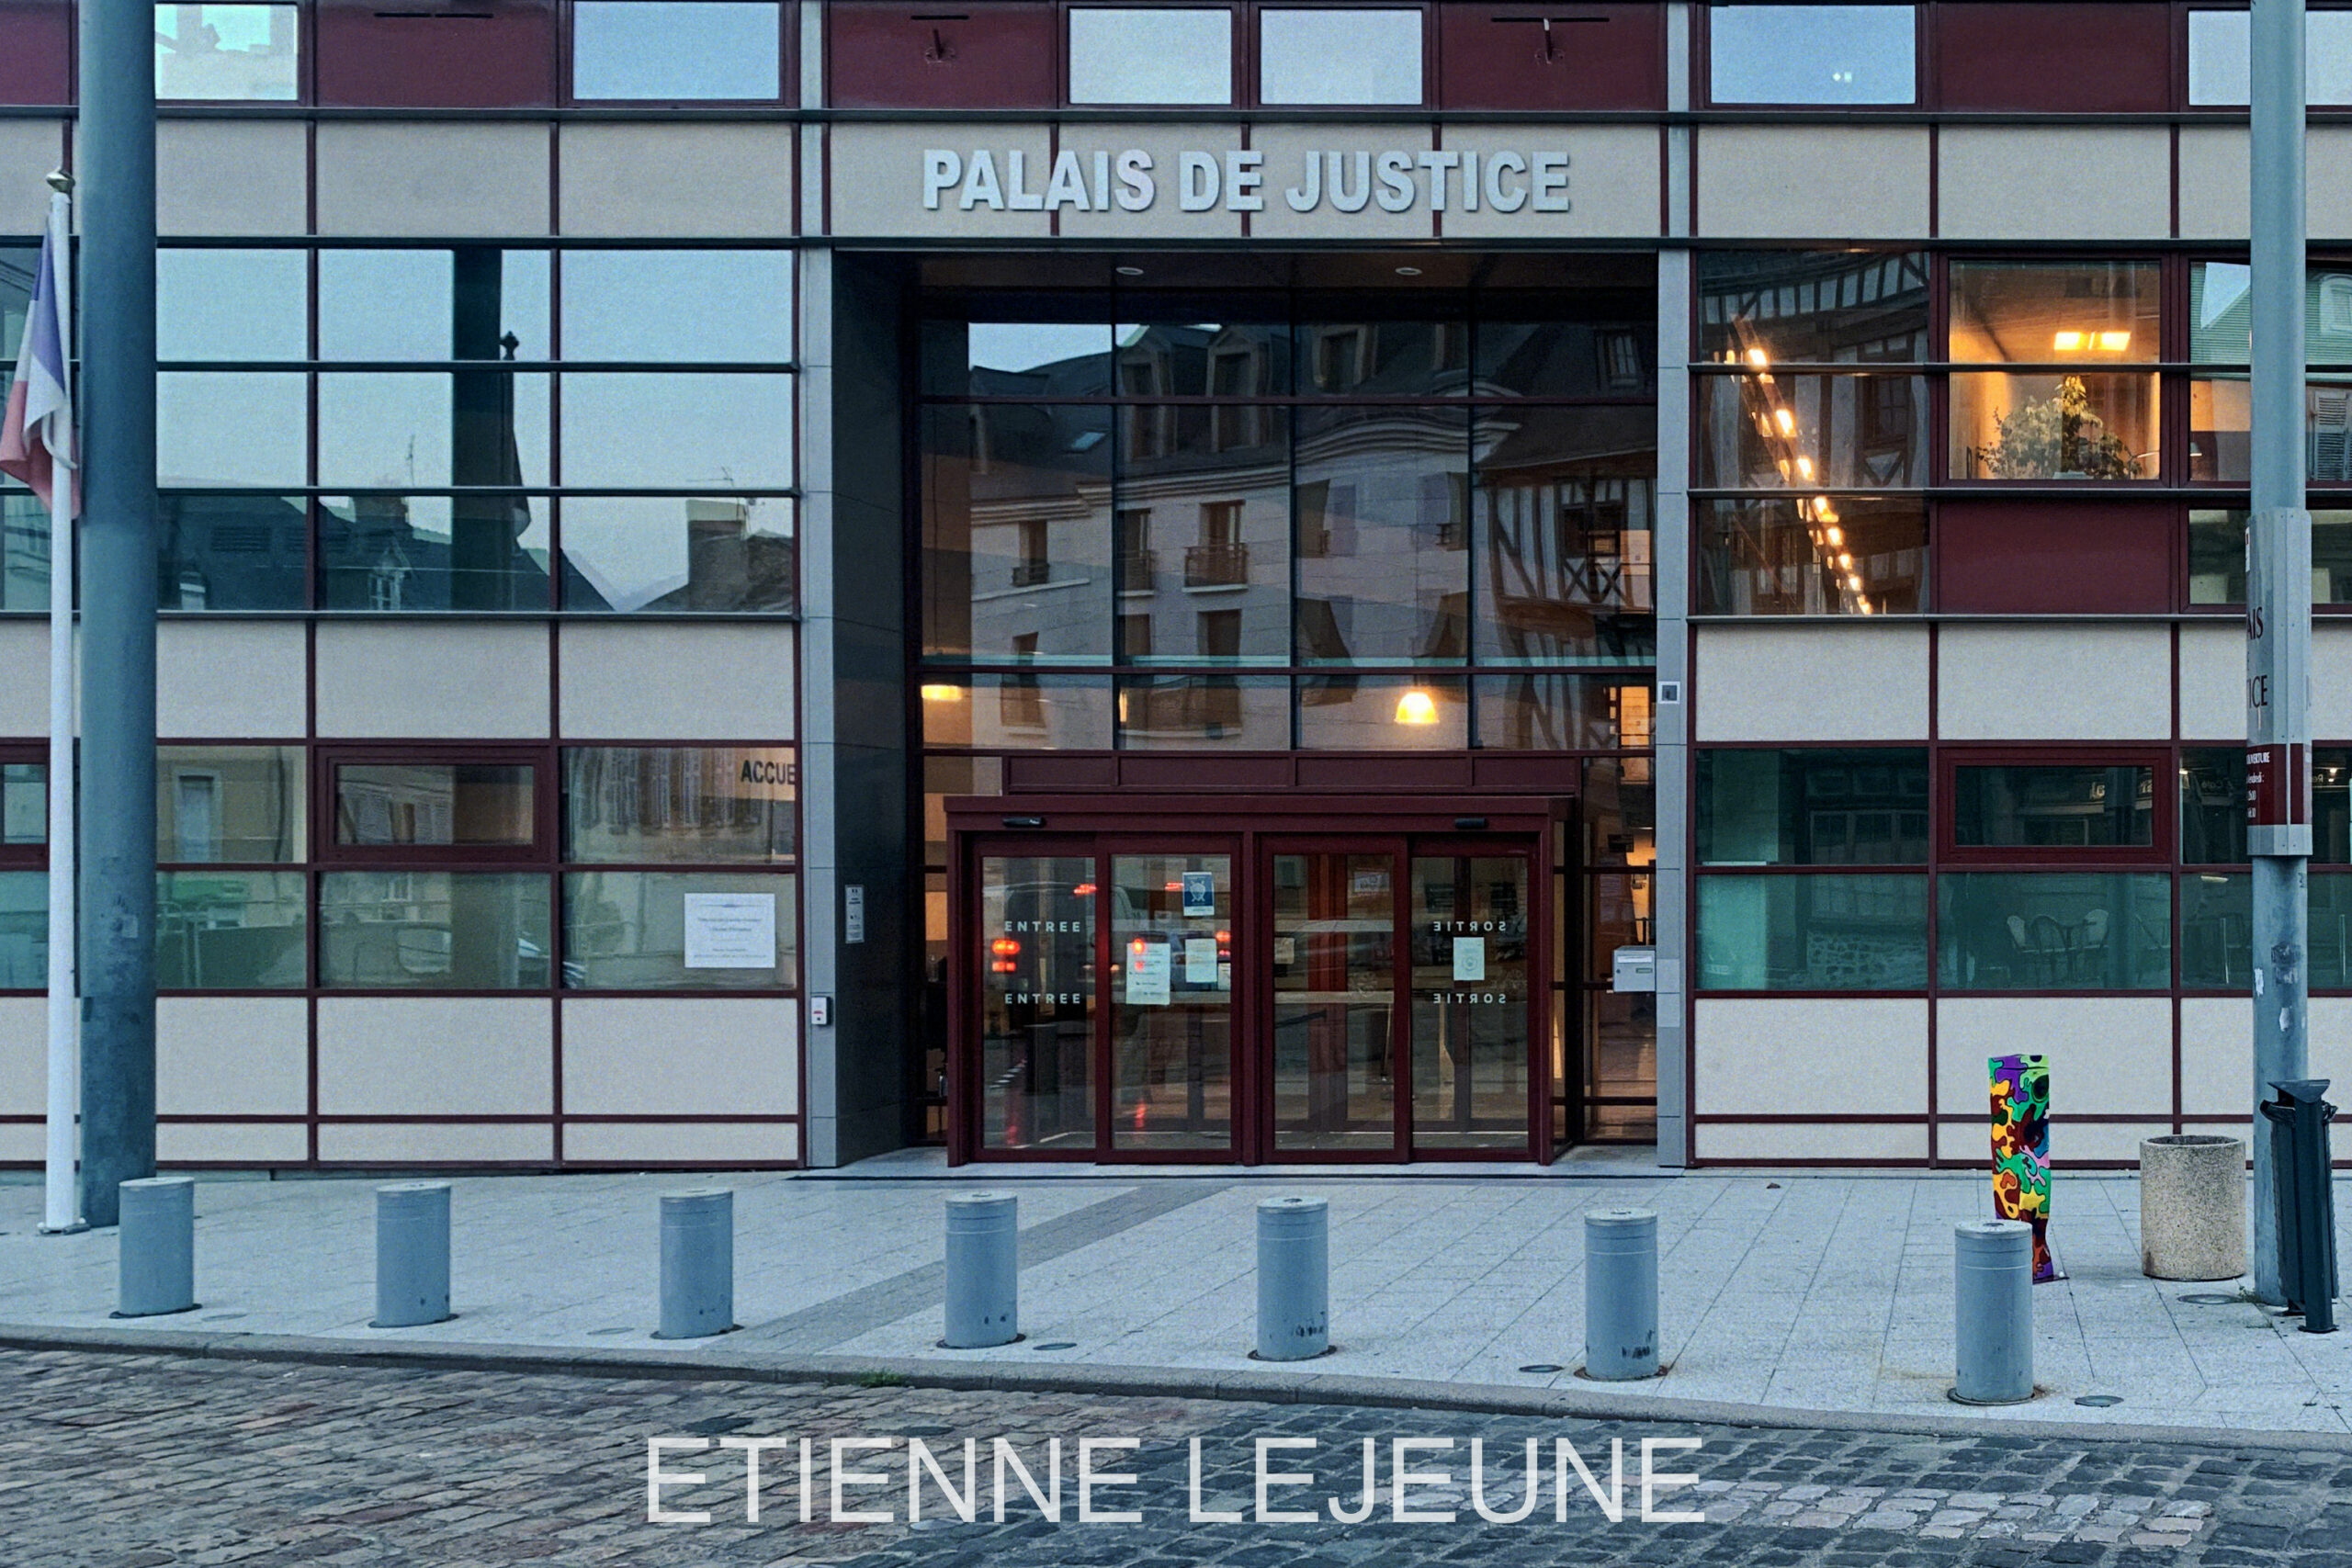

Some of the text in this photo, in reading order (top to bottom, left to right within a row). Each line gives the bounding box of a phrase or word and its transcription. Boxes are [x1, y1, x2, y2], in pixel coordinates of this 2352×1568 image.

[922, 149, 1570, 213] PALAIS DE JUSTICE
[1004, 920, 1081, 932] ENTREE
[1004, 993, 1081, 1005] ENTREE
